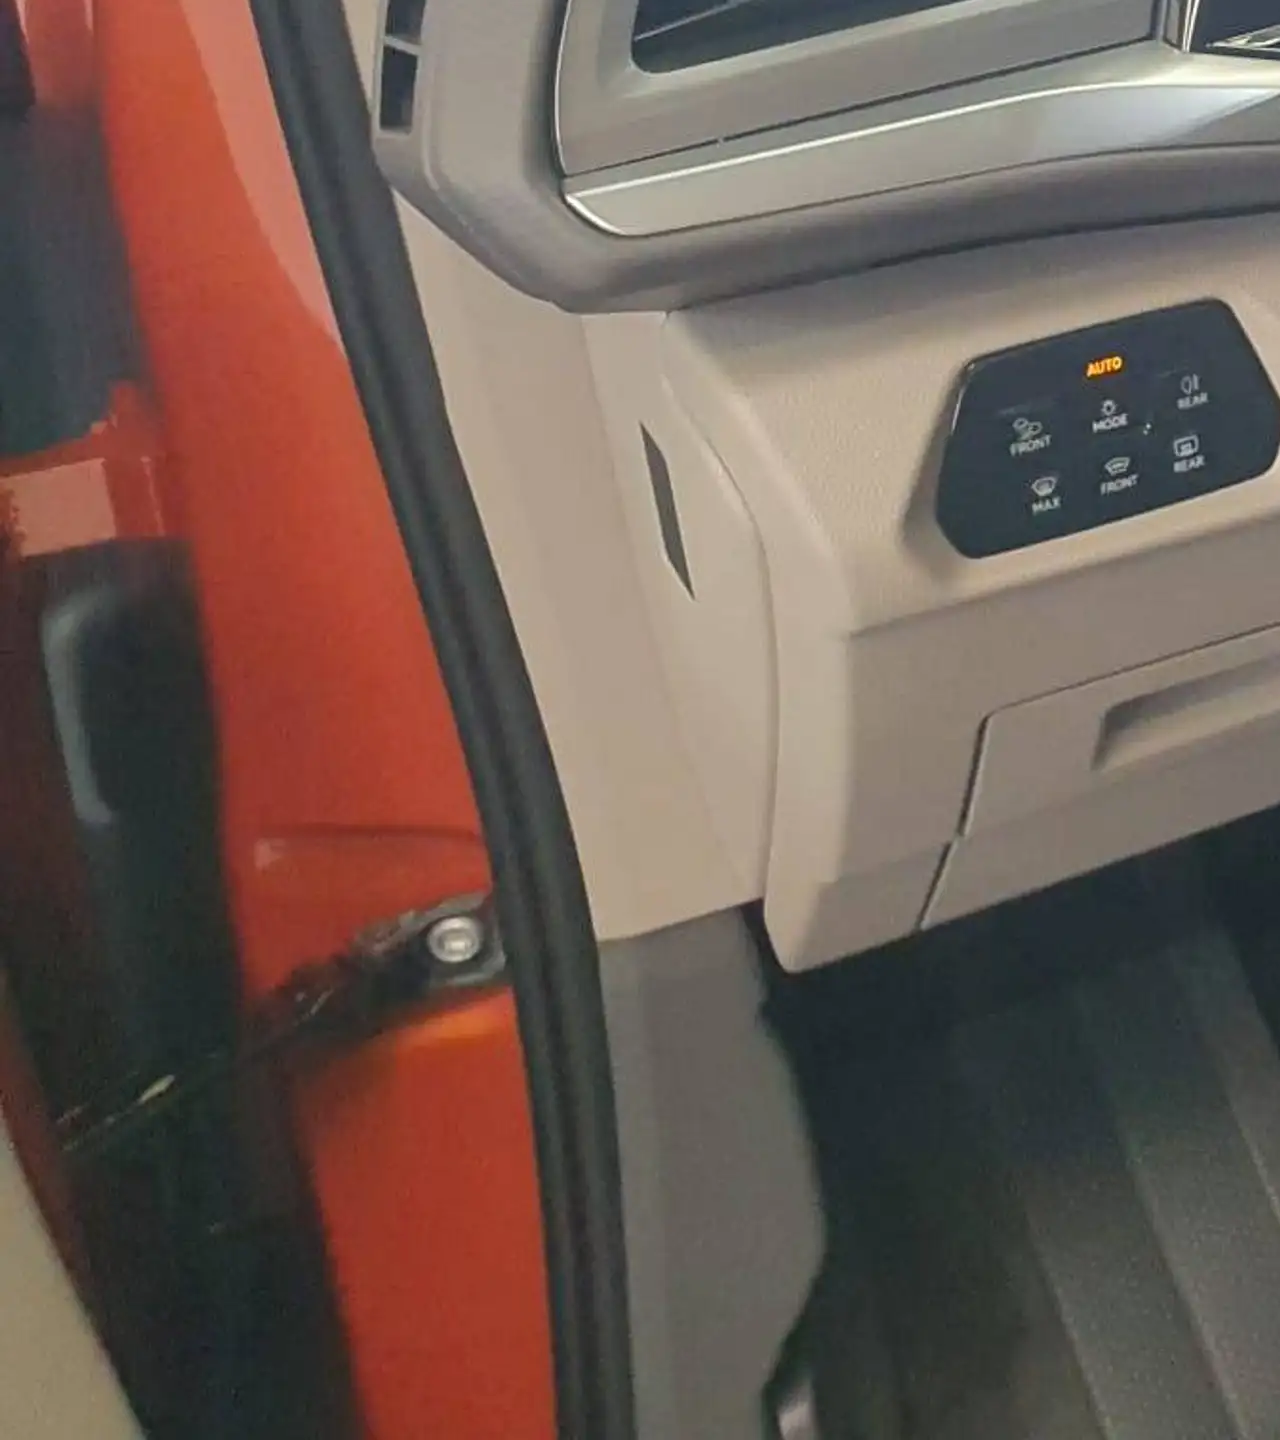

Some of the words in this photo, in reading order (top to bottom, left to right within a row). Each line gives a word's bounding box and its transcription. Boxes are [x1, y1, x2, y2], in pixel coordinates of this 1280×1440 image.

[1086, 356, 1123, 377] AUTO
[1176, 392, 1208, 410] REAR
[1092, 413, 1128, 433] MODE
[1009, 434, 1051, 456] FRONT
[1173, 455, 1205, 473] REAR
[1101, 474, 1139, 495] FRONT
[1032, 496, 1061, 515] MAX
